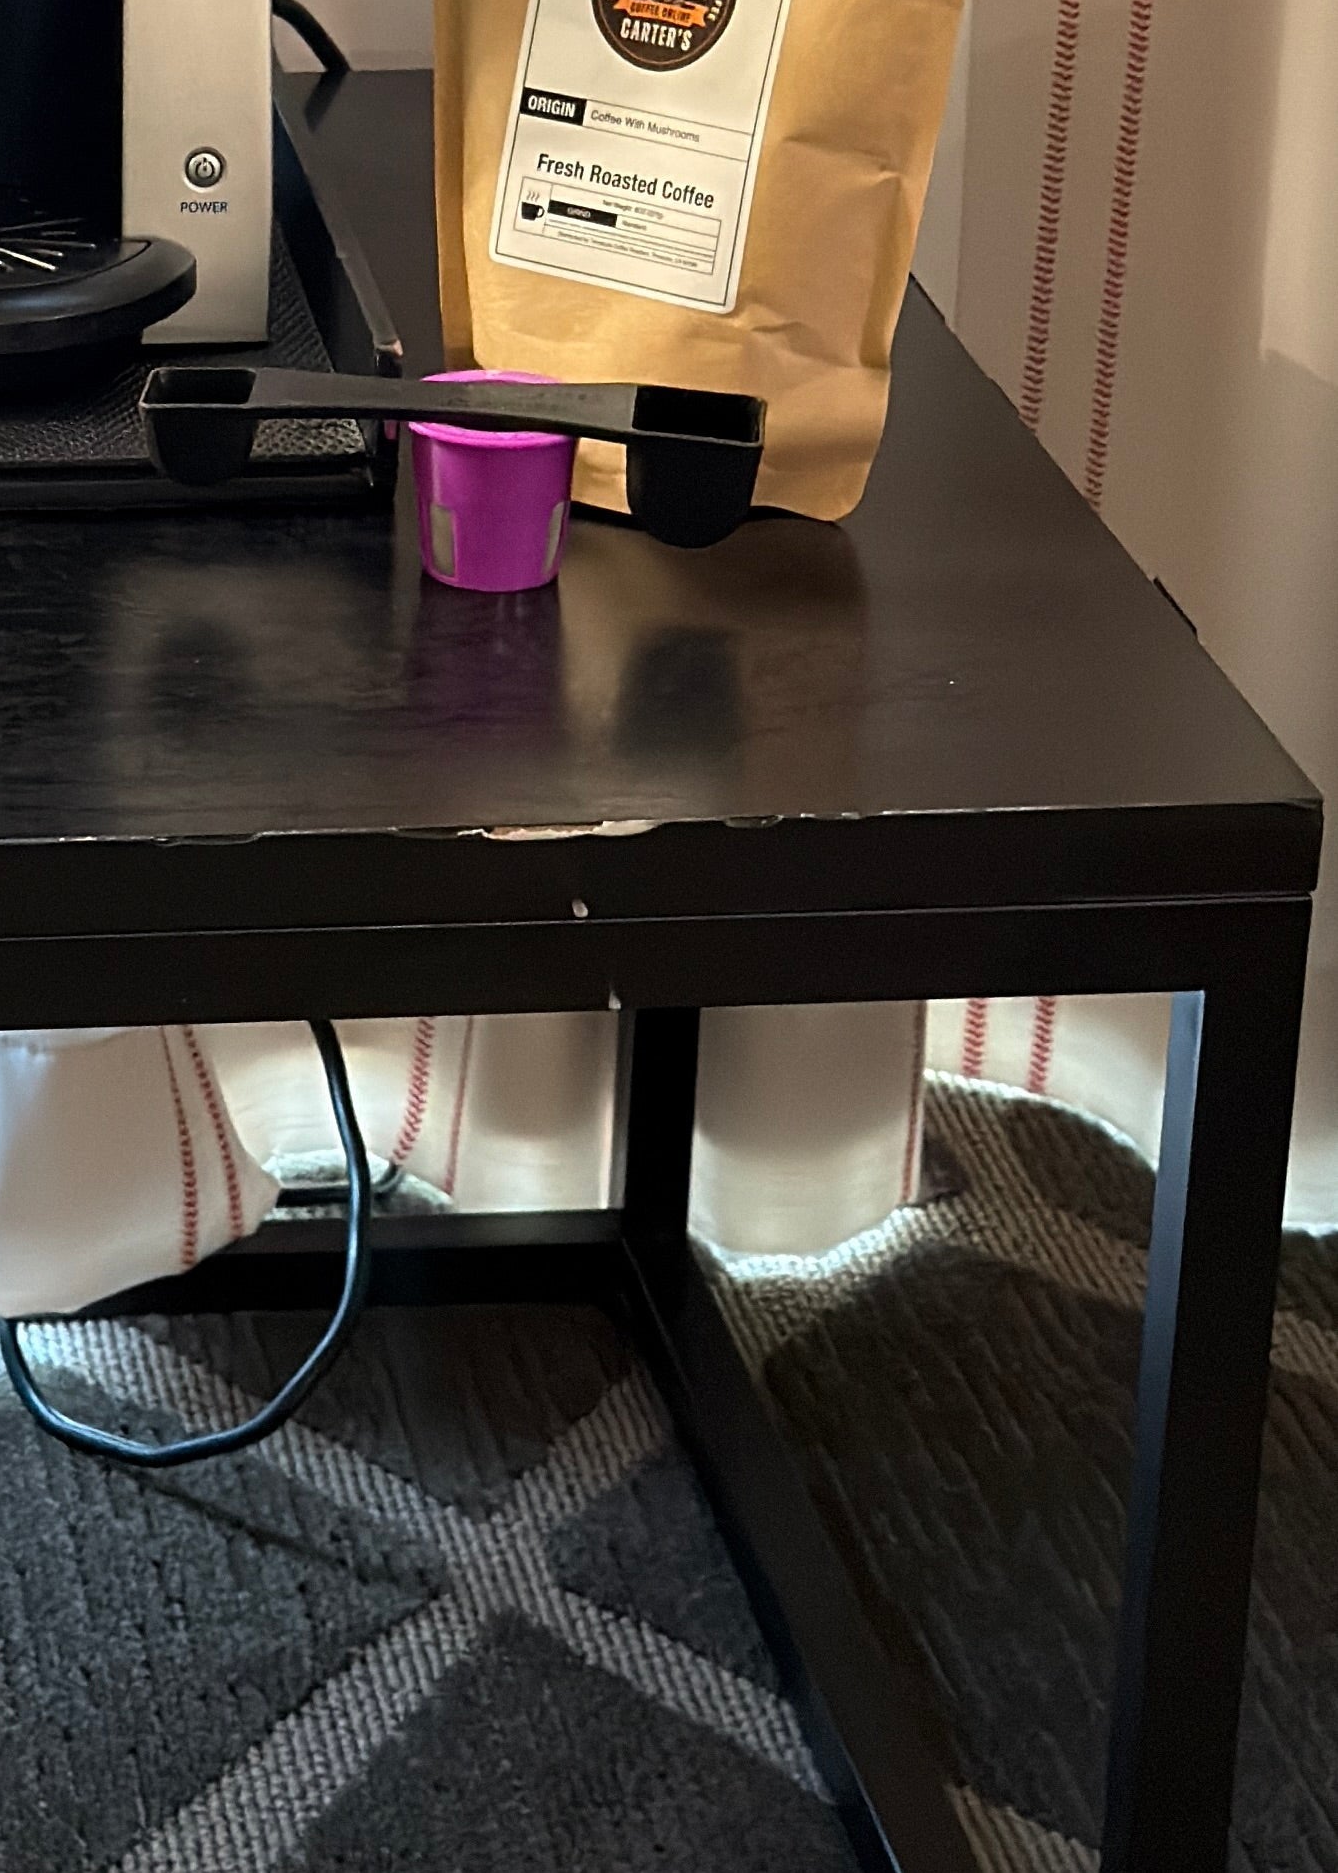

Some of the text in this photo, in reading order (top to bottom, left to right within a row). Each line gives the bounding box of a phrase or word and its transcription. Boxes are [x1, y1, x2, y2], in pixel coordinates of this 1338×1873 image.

[620, 18, 693, 52] CARTER'S
[527, 94, 576, 118] ORIGIN
[590, 109, 700, 143] Coffee With Mushrooms
[536, 153, 715, 209] Fresh Roasted Coffee
[180, 201, 228, 214] POWER
